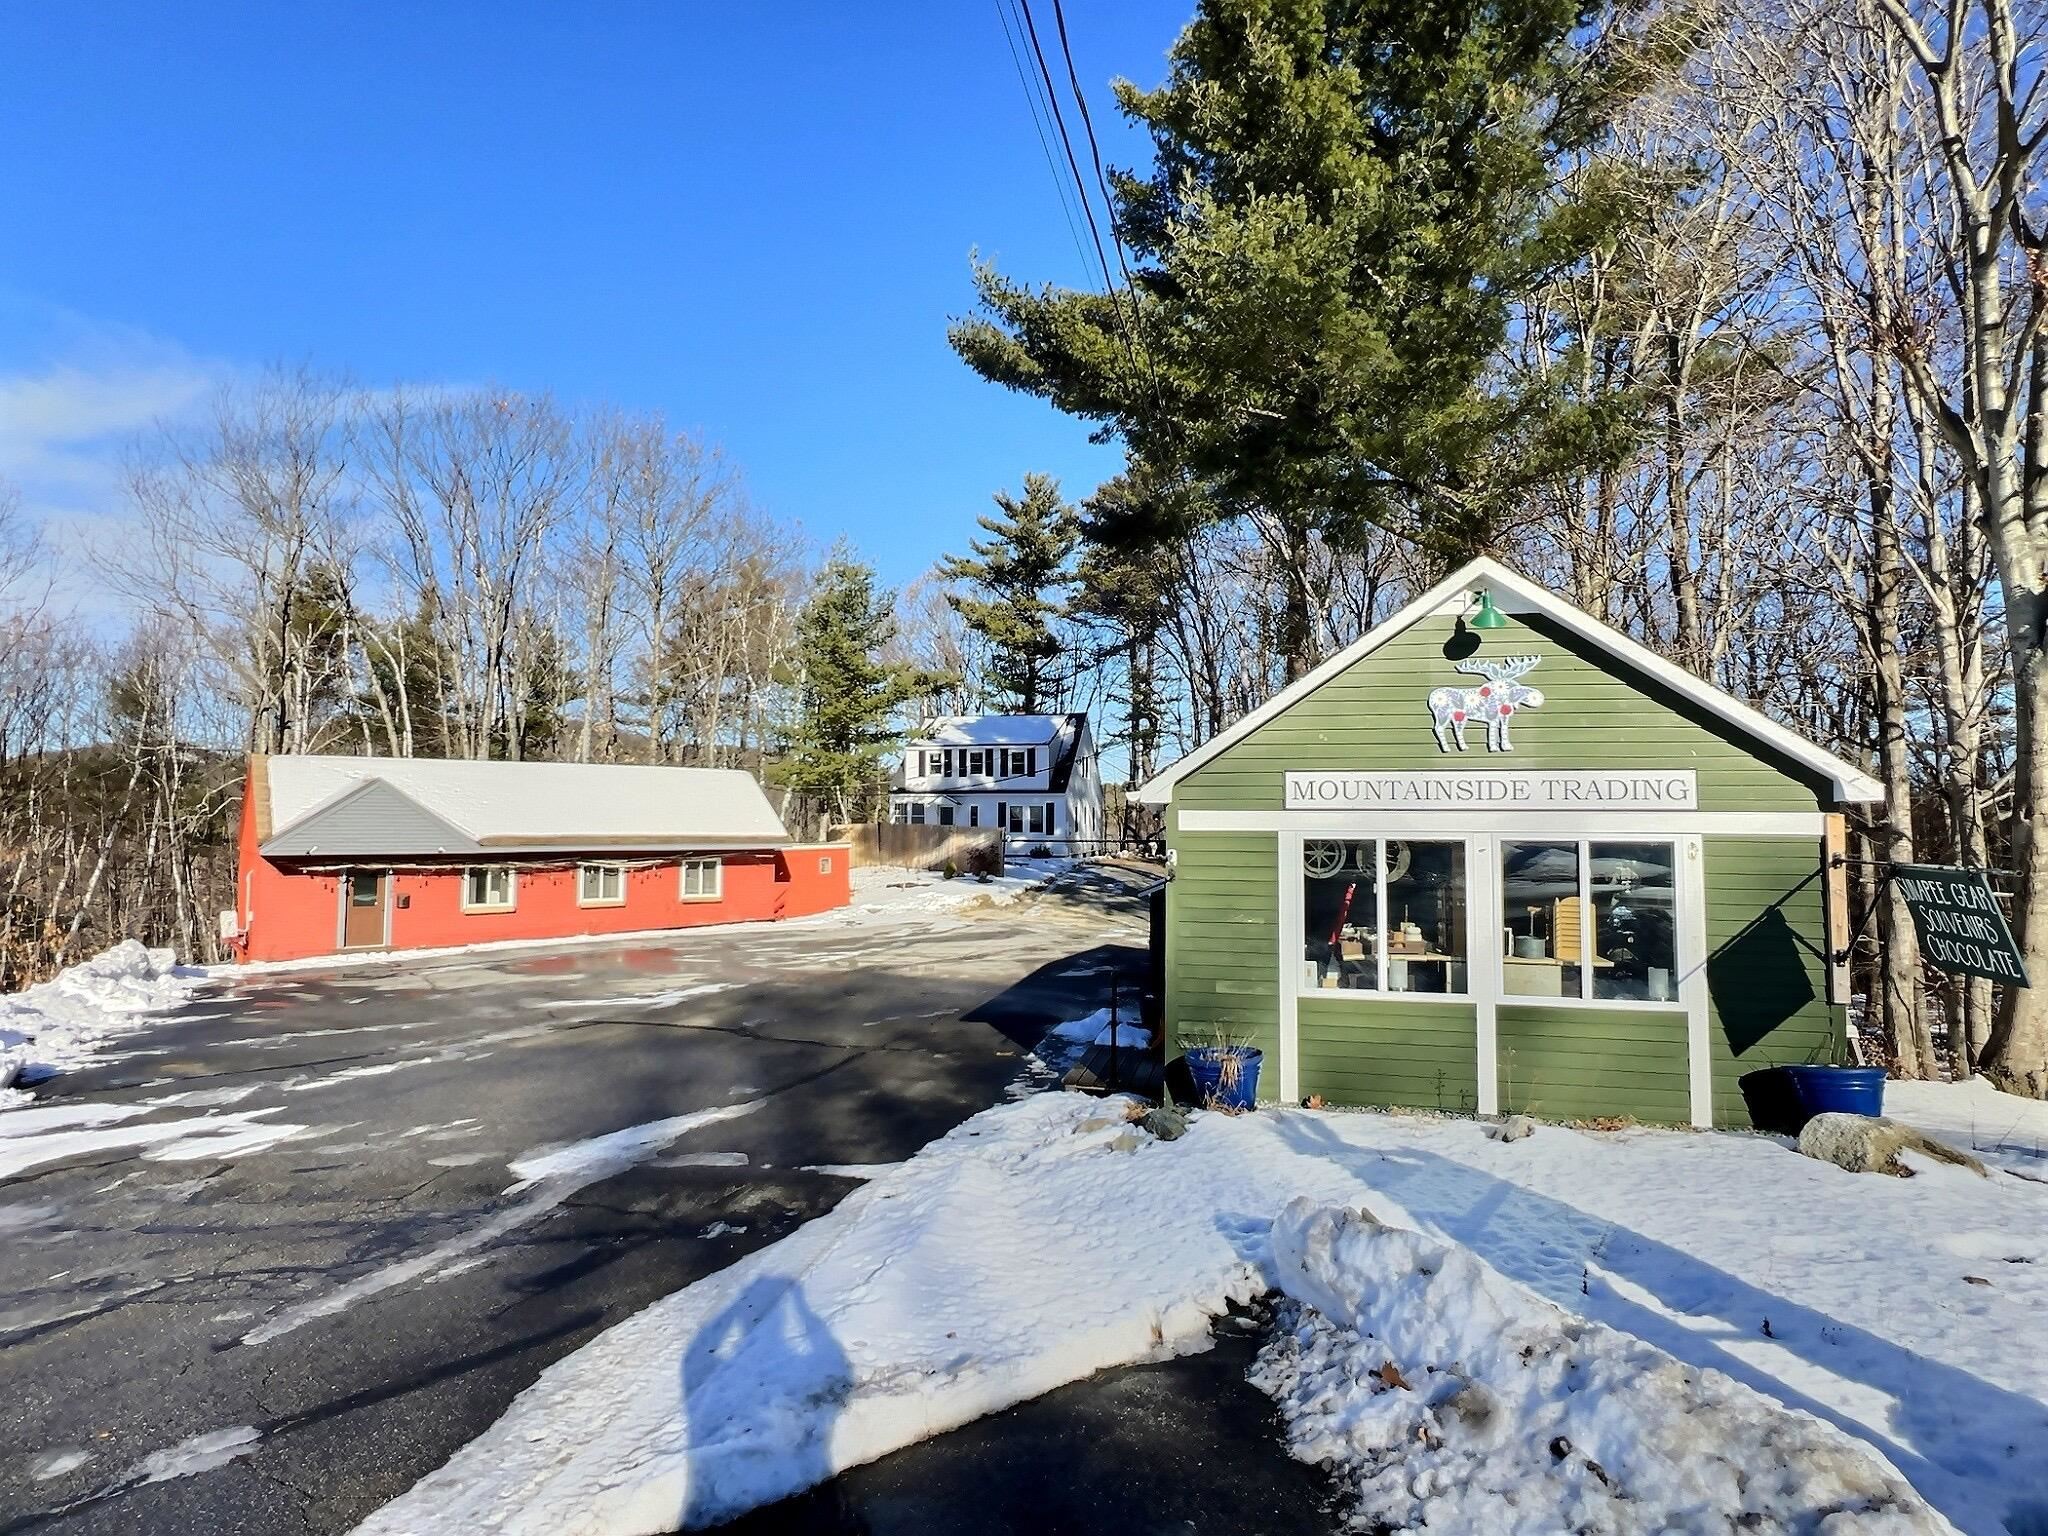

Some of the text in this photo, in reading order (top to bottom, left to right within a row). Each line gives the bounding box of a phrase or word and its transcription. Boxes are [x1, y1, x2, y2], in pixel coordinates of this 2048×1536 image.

[1291, 779, 1691, 801] MOUNTAINSIDE TRADING
[1895, 877, 1997, 914] SUNAPEE GEAR
[1919, 905, 1999, 944] SOUVENIRS
[1927, 934, 2021, 978] CHOCOLATE
